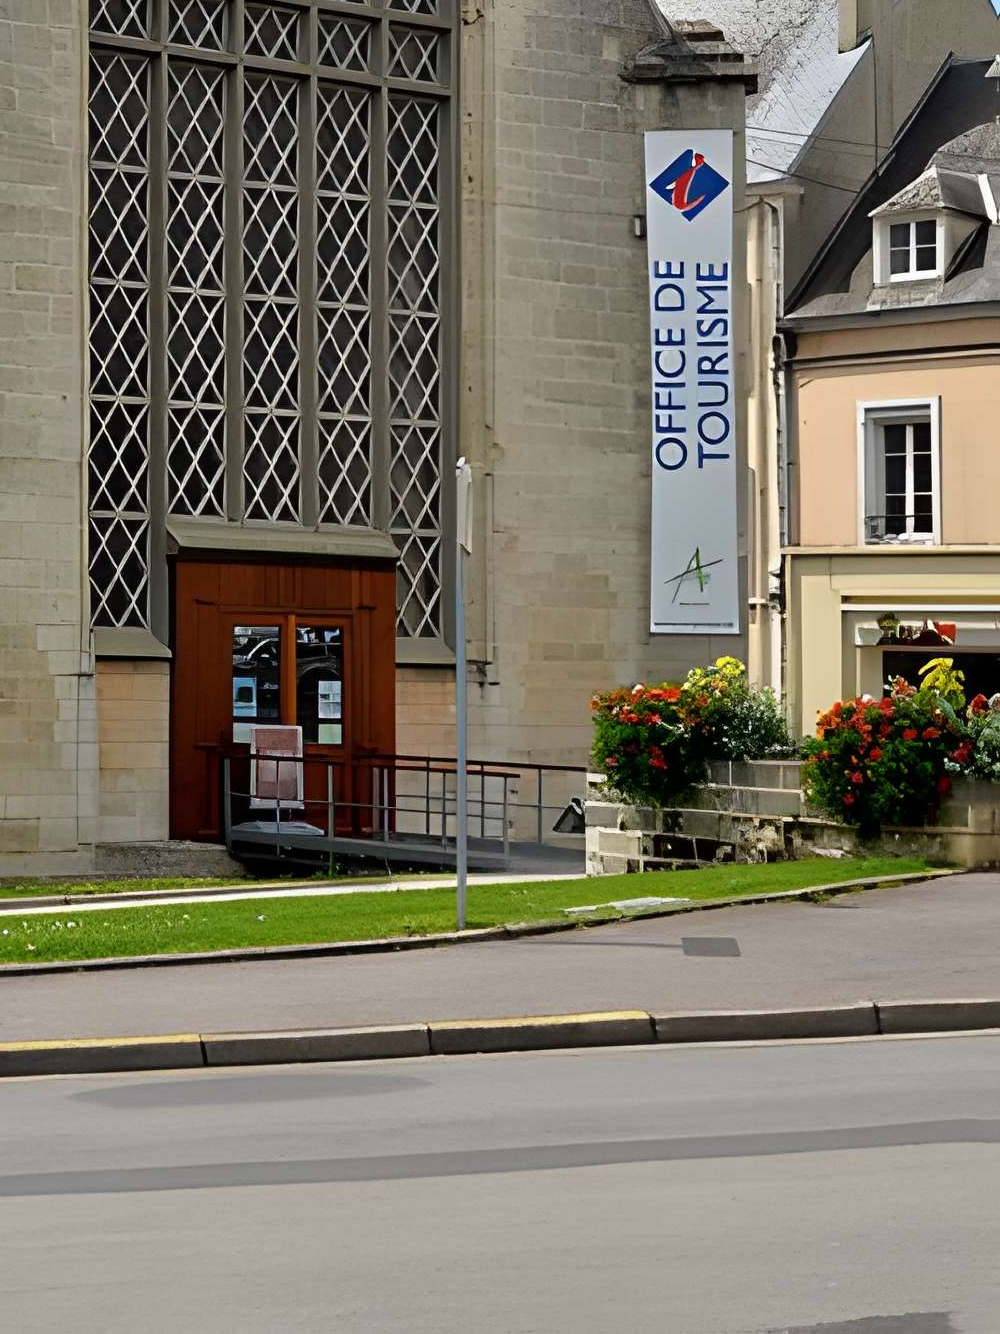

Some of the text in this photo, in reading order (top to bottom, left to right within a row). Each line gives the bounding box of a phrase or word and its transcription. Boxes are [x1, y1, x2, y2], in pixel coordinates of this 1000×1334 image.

[653, 260, 688, 471] OFFICE DE
[695, 261, 731, 469] TOURISME
